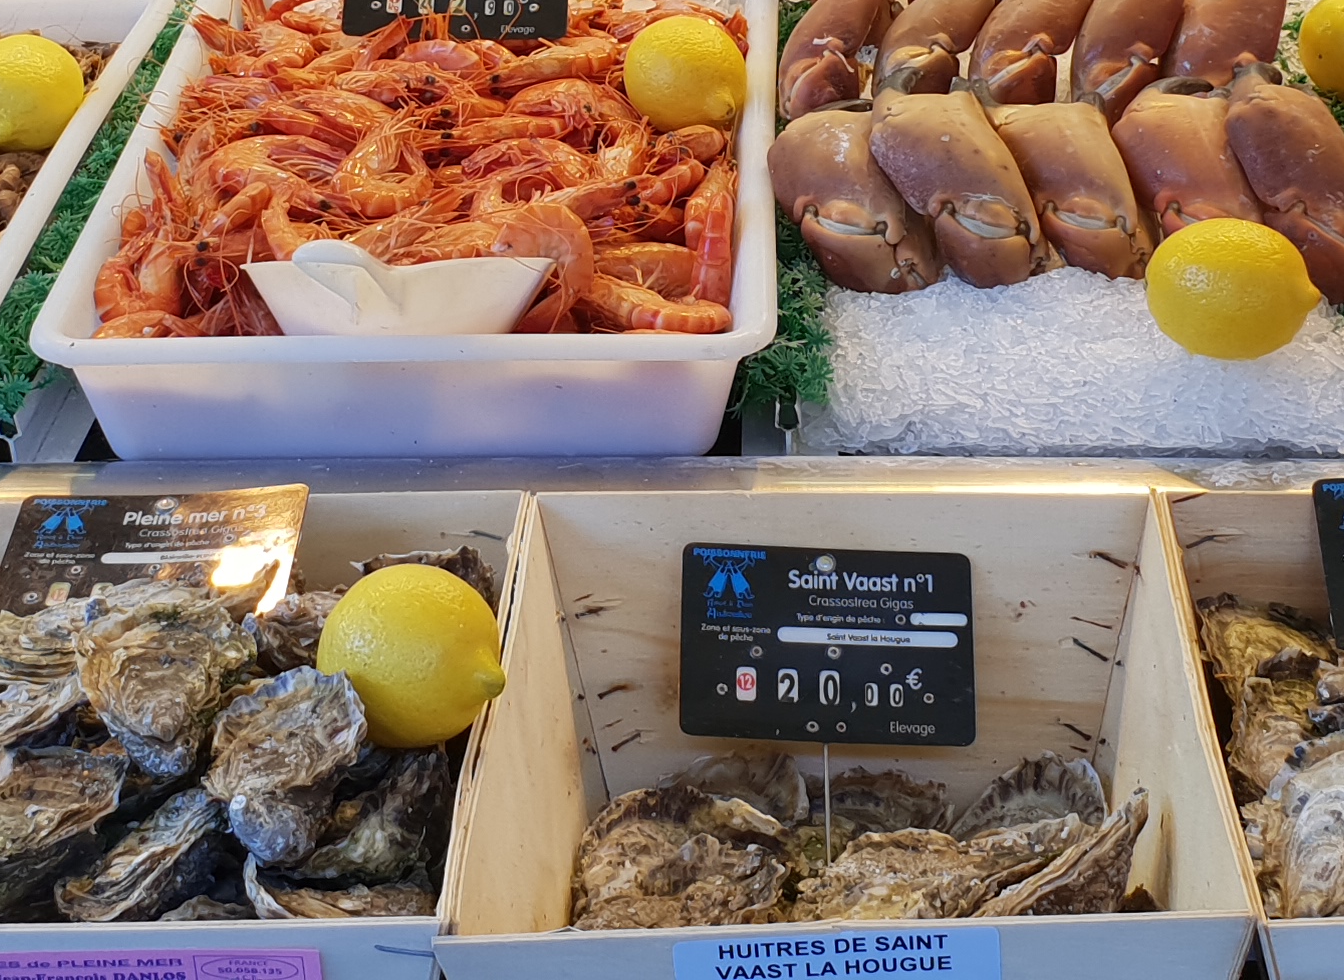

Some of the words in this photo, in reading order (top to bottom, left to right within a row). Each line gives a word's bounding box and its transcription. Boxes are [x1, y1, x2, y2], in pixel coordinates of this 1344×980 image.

[123, 511, 182, 526] Pleine
[188, 509, 228, 524] mer
[232, 505, 267, 521] n°3
[788, 569, 838, 590] Saint
[843, 572, 899, 592] Vaast
[903, 574, 934, 592] n°1
[809, 595, 876, 609] Crassostrea
[880, 597, 914, 610] Gigas
[719, 941, 826, 959] HUITRES
[834, 937, 867, 954] DE
[875, 934, 948, 952] SAINT
[27, 959, 51, 969] de
[58, 959, 130, 969] PLEINE
[136, 957, 183, 967] MER
[716, 962, 797, 980] VAAST
[805, 961, 836, 977] LA
[844, 956, 953, 974] HOUGUE
